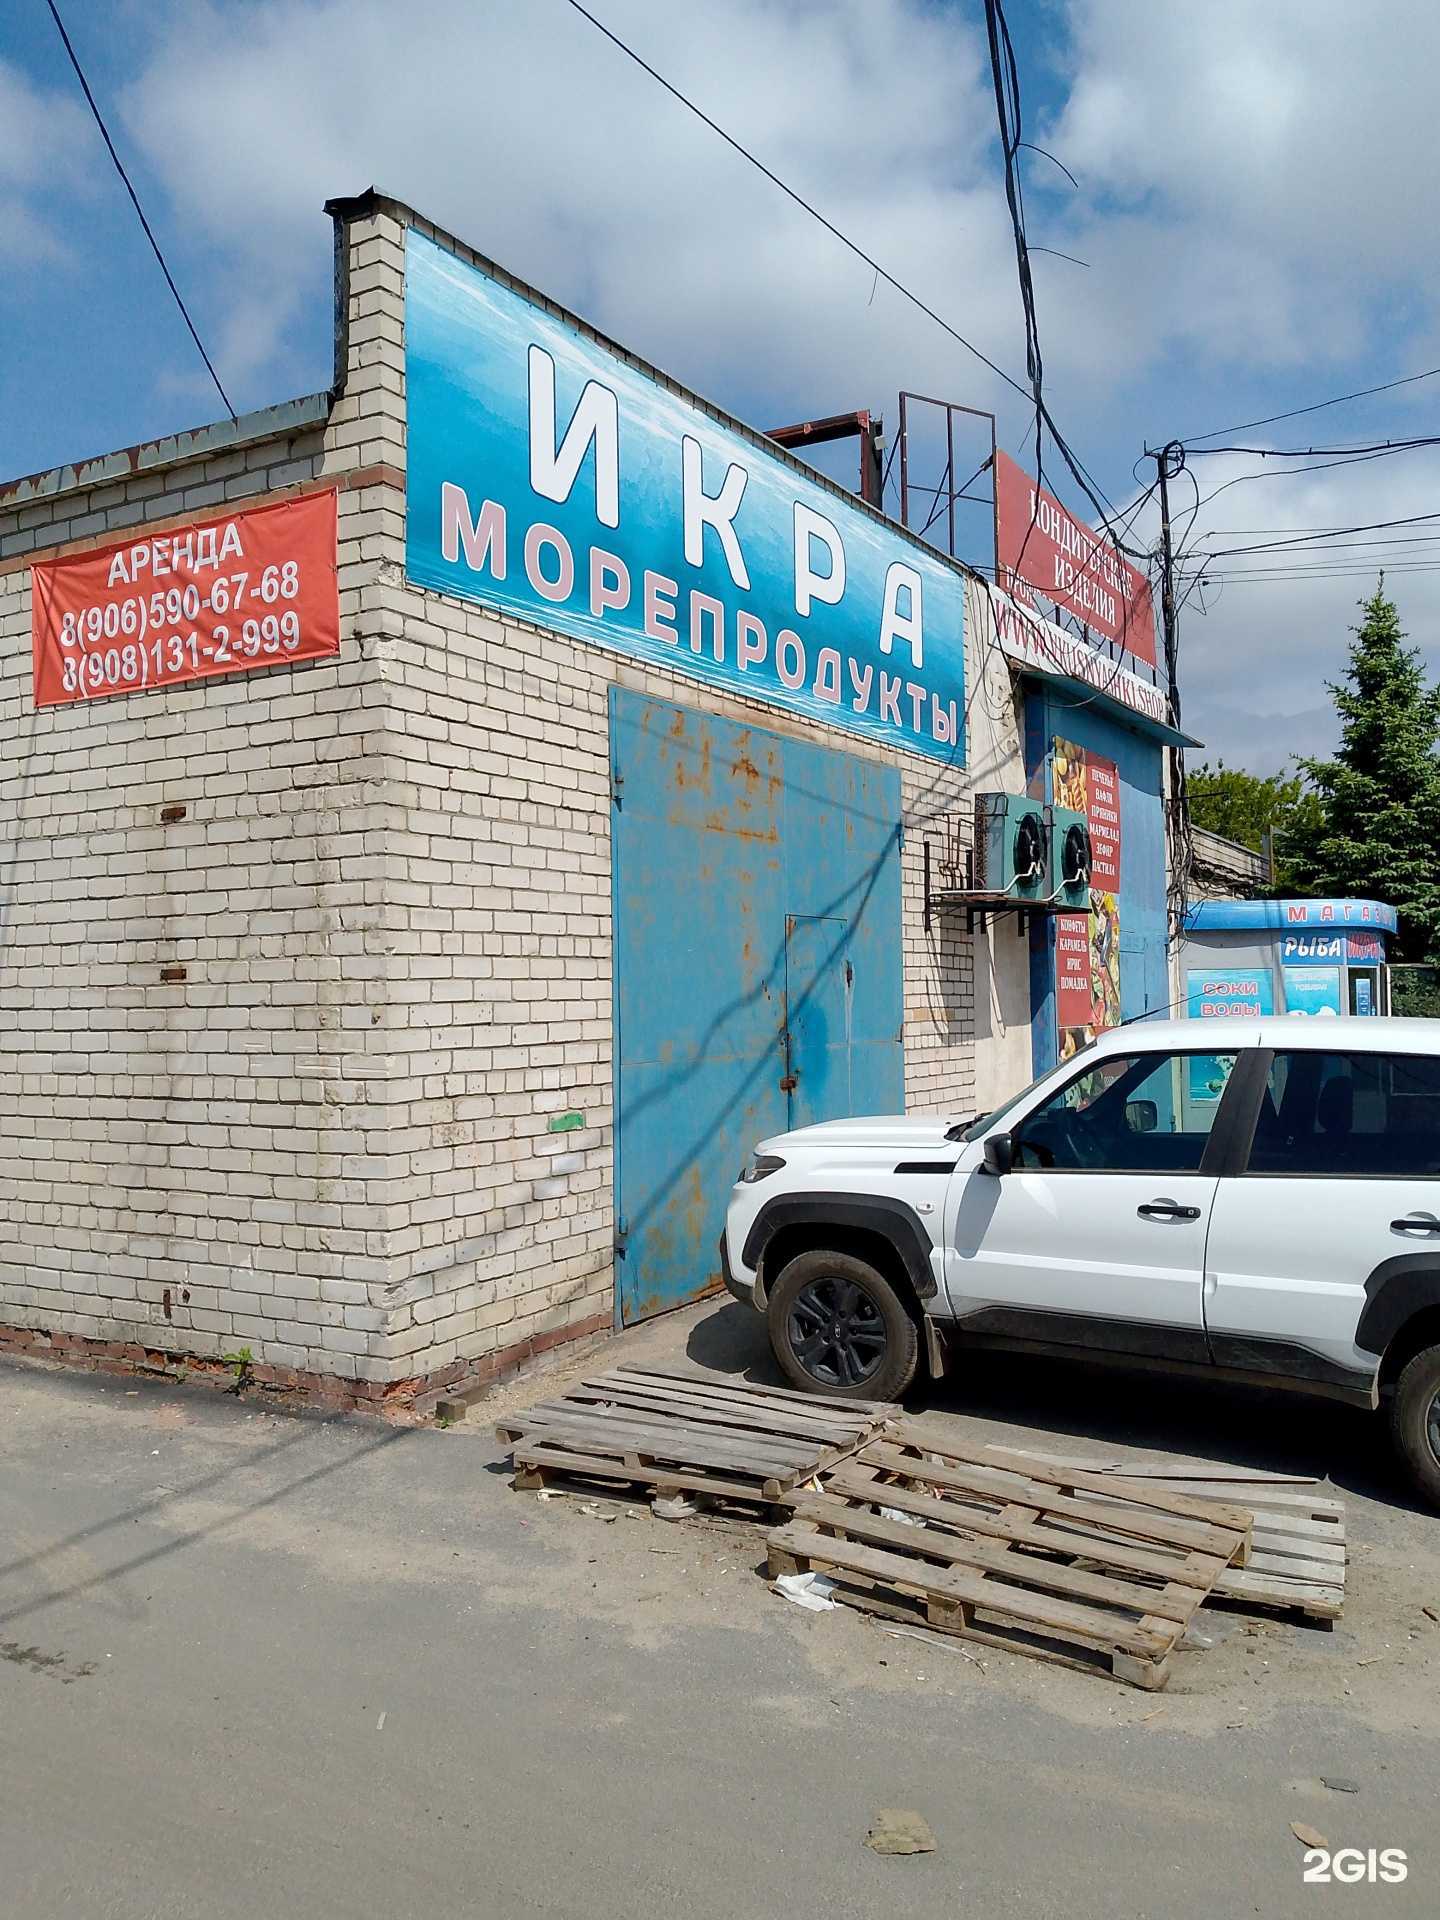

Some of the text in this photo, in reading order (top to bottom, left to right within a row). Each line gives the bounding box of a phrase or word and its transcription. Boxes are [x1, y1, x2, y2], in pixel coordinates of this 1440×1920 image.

[527, 343, 924, 669] ИКРА
[1029, 488, 1133, 602] КОНДИТЕРСКИЕ
[107, 522, 244, 588] АРЕНДА
[1054, 554, 1117, 628] ИЗДЕЛИЯ
[60, 560, 299, 651] 8(906)590-67-68
[441, 480, 958, 747] МОРЕПРОДУКТЫ
[62, 610, 300, 698] 8(908)131-2-999
[1095, 788, 1113, 805] ВАФЛИ
[1091, 805, 1118, 824] ПРЯНИКИ
[1089, 822, 1120, 844] МАРМЕЛАД
[1095, 841, 1114, 857] ЗЕФИР
[1092, 860, 1115, 876] ПАСТИЛА
[1060, 918, 1086, 934] КОНФЕТЫ
[1059, 938, 1087, 952] КАРАМЕЛЬ
[1284, 936, 1341, 957] РЫБА
[1066, 957, 1082, 971] ИРИС
[1060, 976, 1088, 991] ПОМАДКА
[1203, 982, 1257, 996] СОКИ
[1202, 1003, 1260, 1017] ВОДЫ
